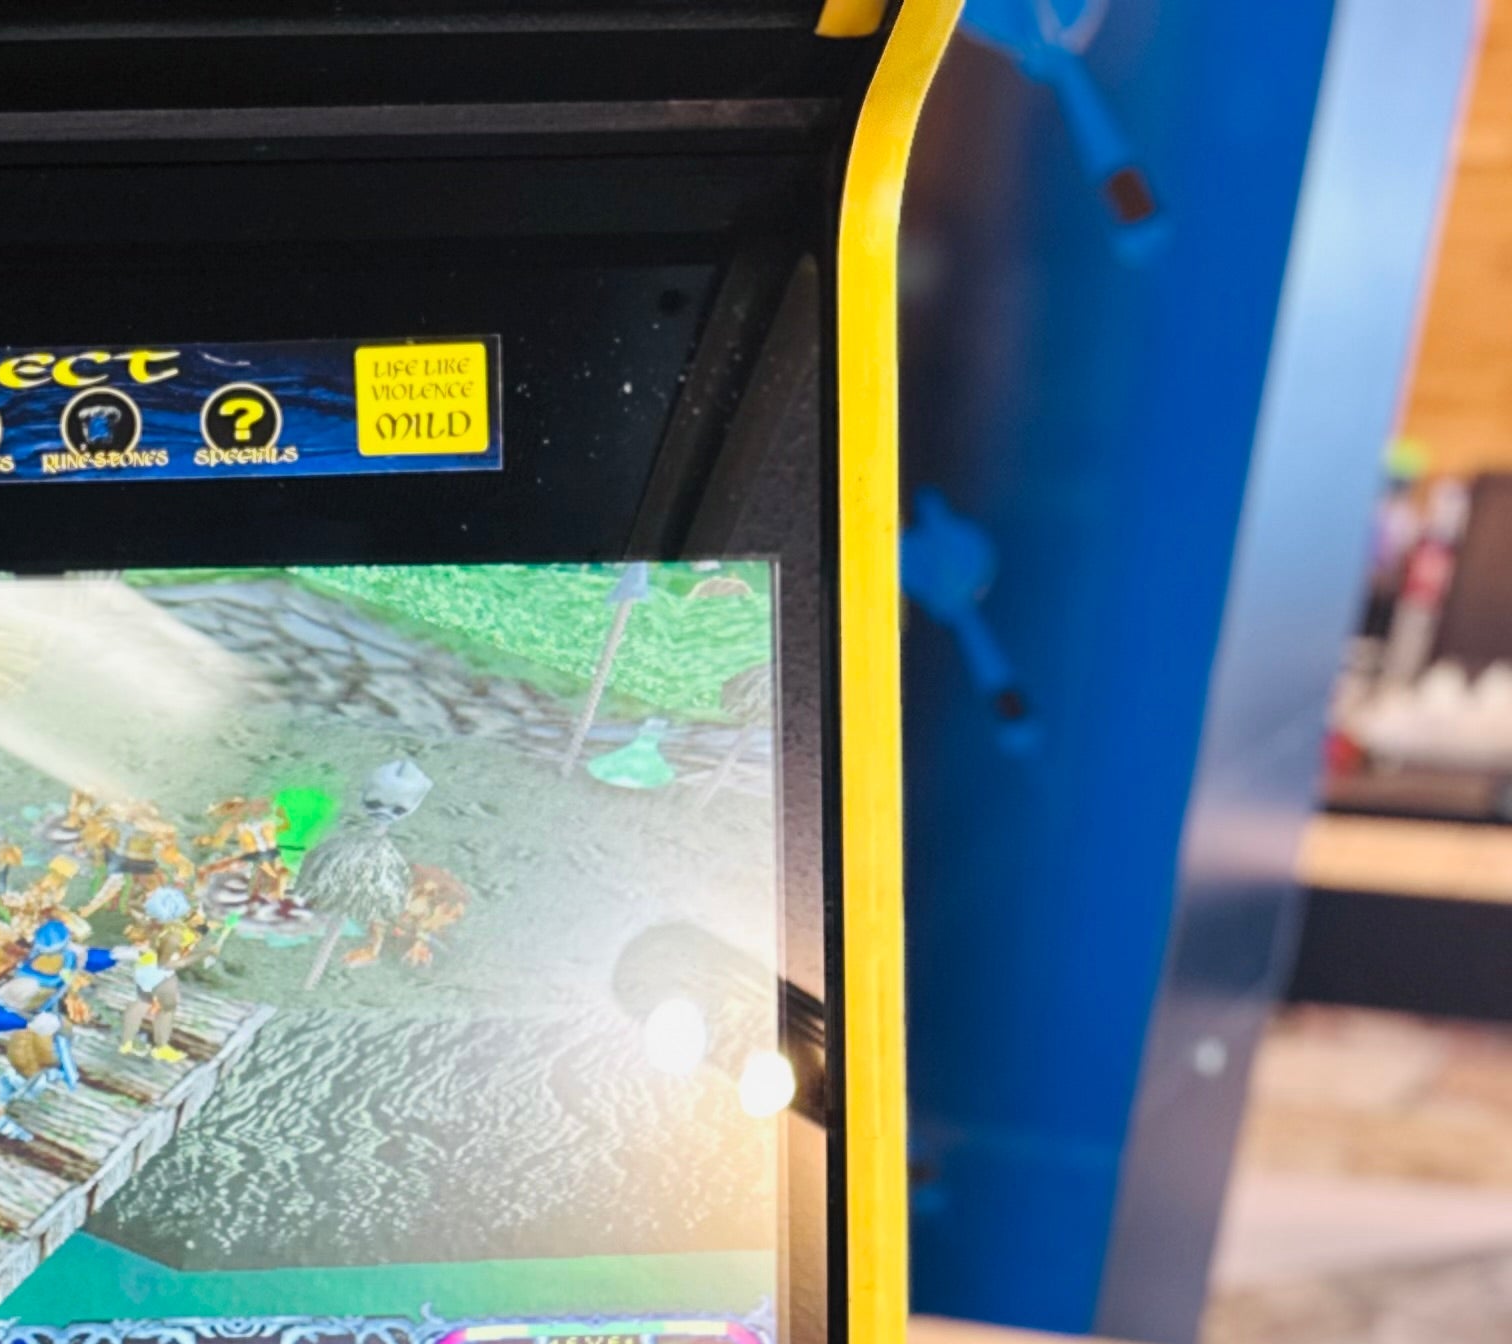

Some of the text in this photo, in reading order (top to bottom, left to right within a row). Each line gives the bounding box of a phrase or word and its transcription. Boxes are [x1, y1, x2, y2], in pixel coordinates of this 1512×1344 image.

[374, 358, 470, 379] LIFE LIKE
[371, 381, 474, 402] VIOLENCE
[375, 410, 472, 440] MILD
[193, 446, 299, 467] SPECIALS
